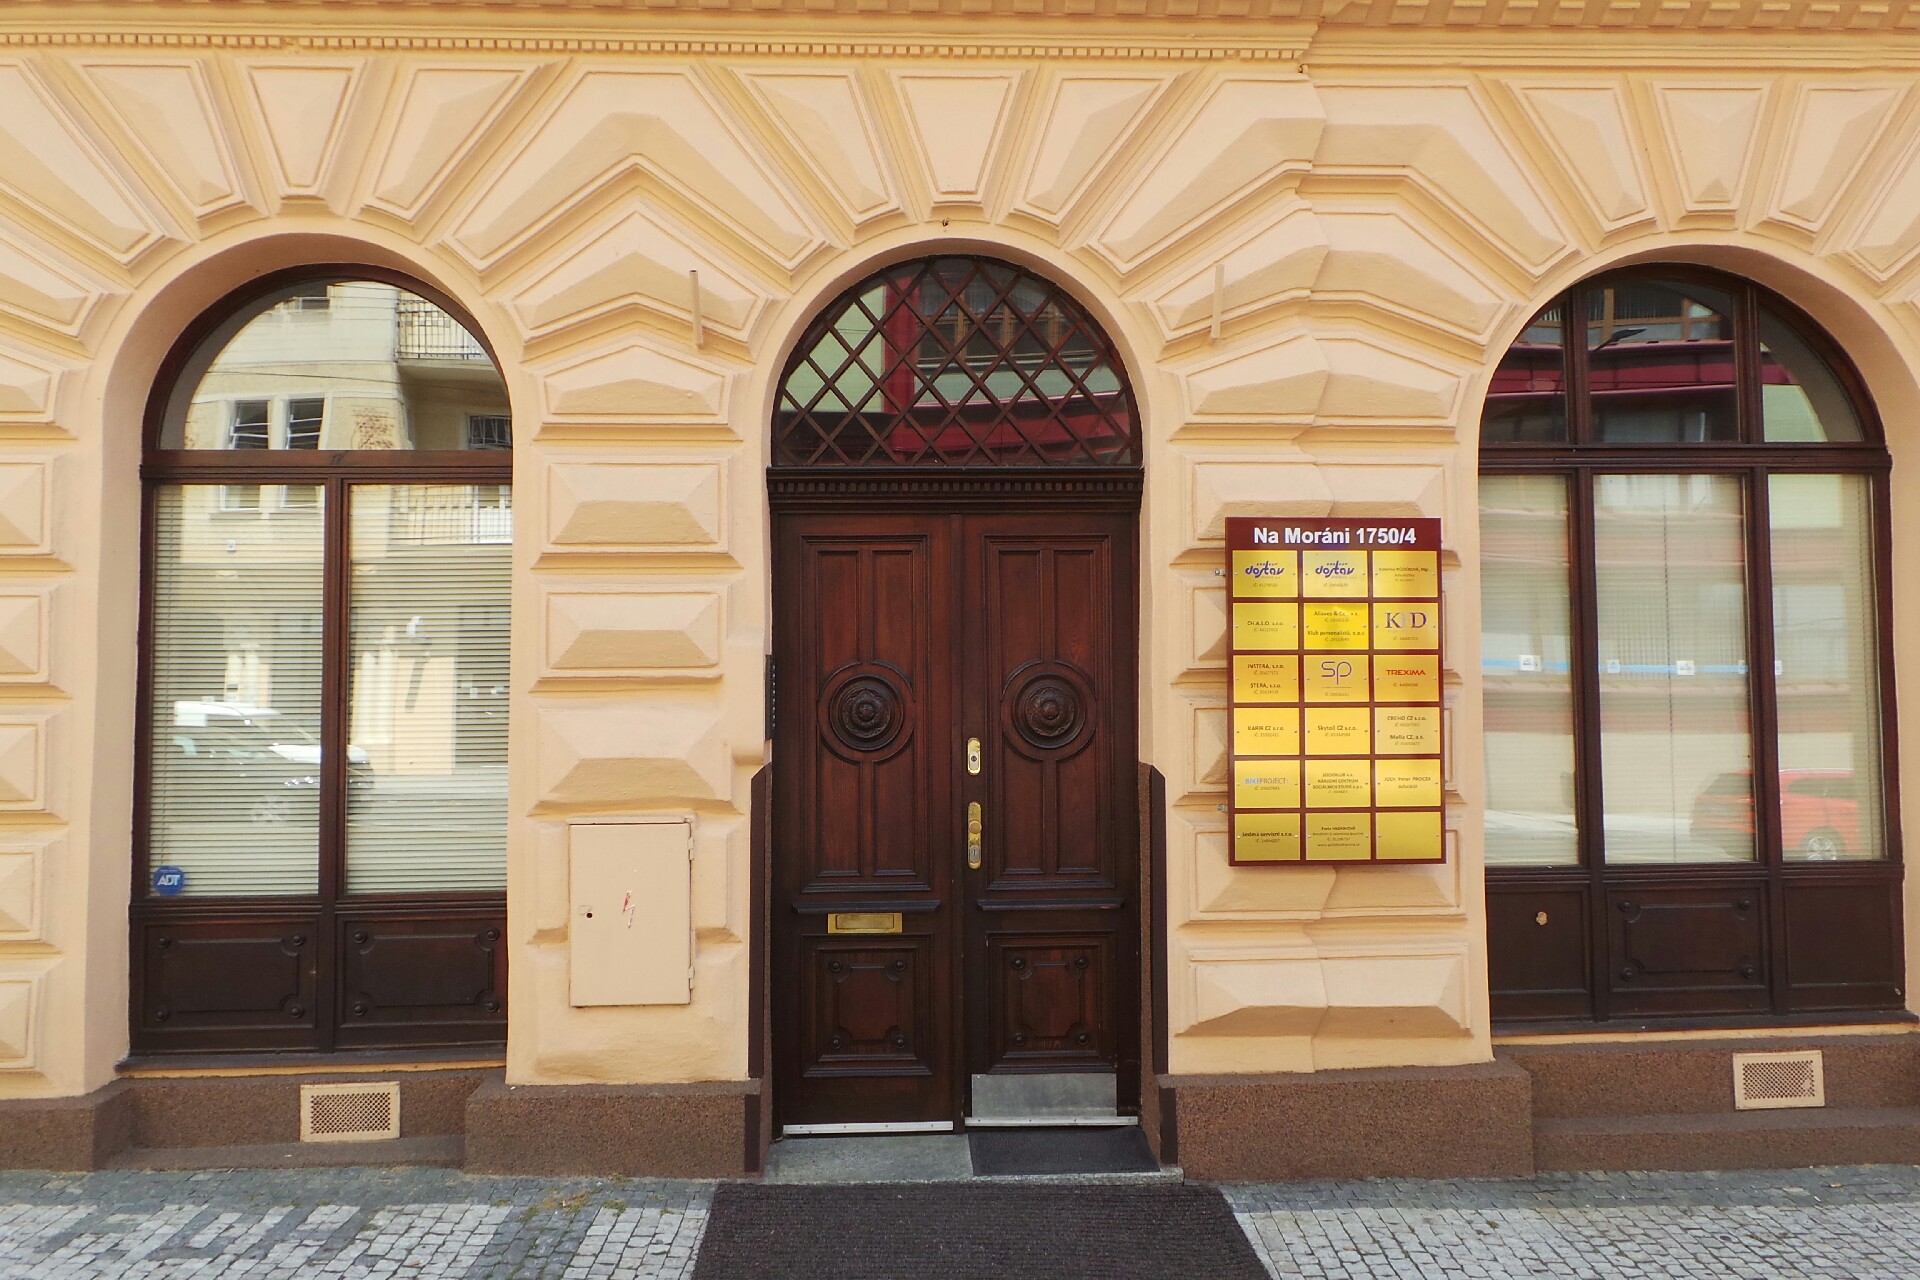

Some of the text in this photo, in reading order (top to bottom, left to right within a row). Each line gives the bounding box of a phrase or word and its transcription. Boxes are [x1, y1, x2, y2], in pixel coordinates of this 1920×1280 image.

[1254, 526, 1416, 544] Na Moráni 1750/4
[157, 874, 180, 886] ADT
